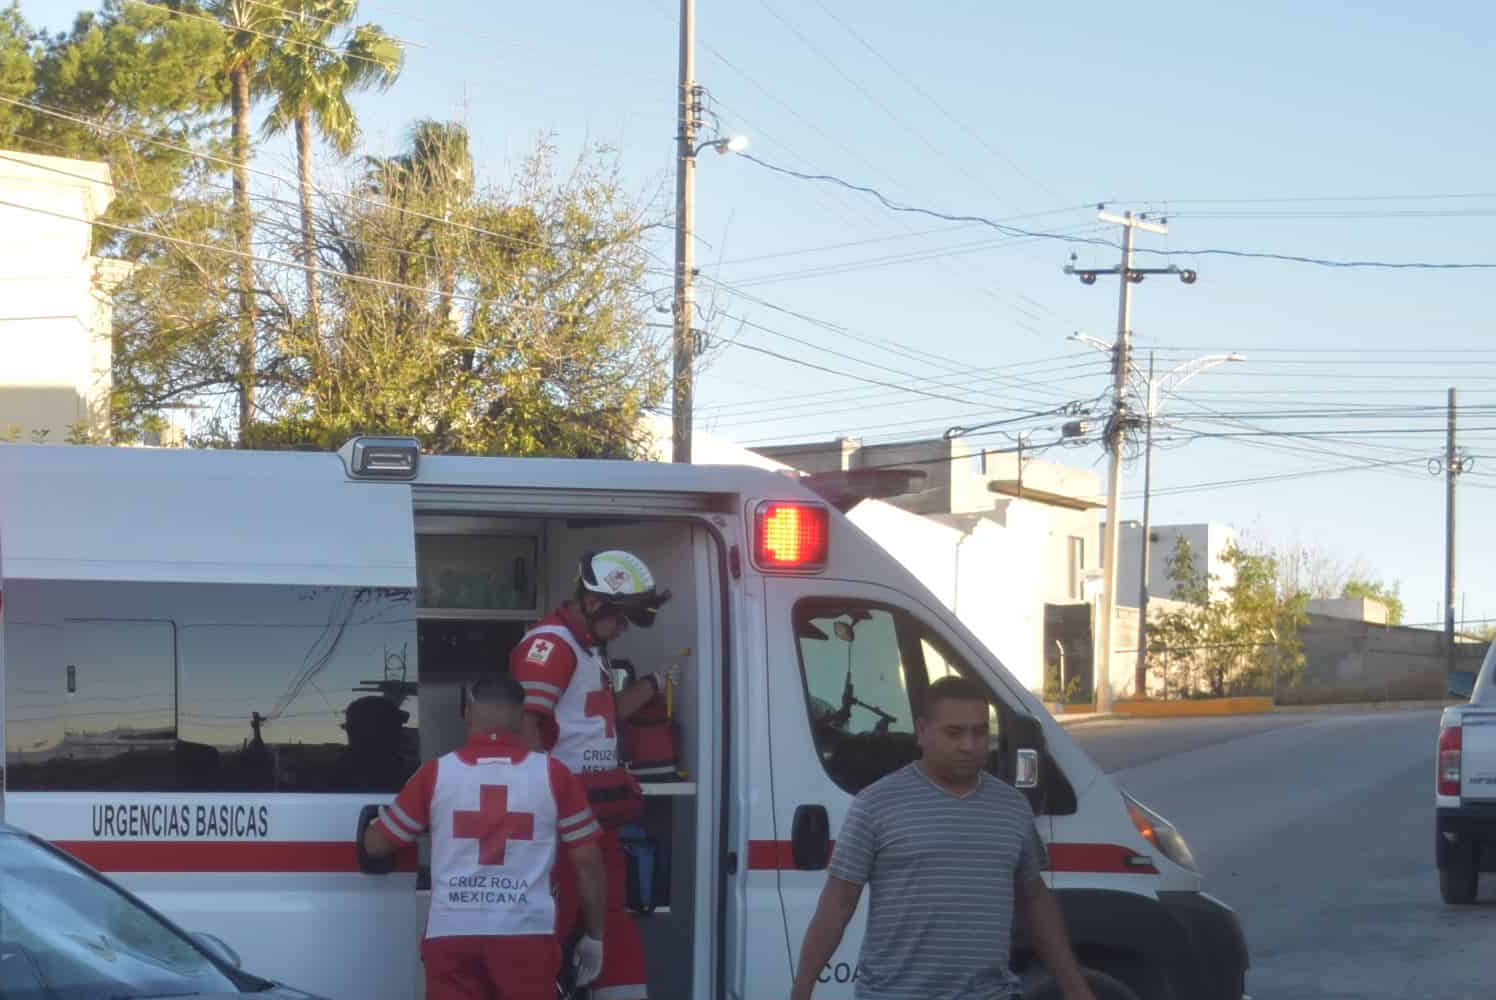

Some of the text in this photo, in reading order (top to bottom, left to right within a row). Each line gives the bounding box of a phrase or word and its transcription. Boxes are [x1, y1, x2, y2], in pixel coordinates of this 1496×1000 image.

[92, 804, 269, 837] URGENCIAS BASICAS
[448, 876, 529, 889] CRUZ ROJA
[448, 891, 529, 904] MEXICANA
